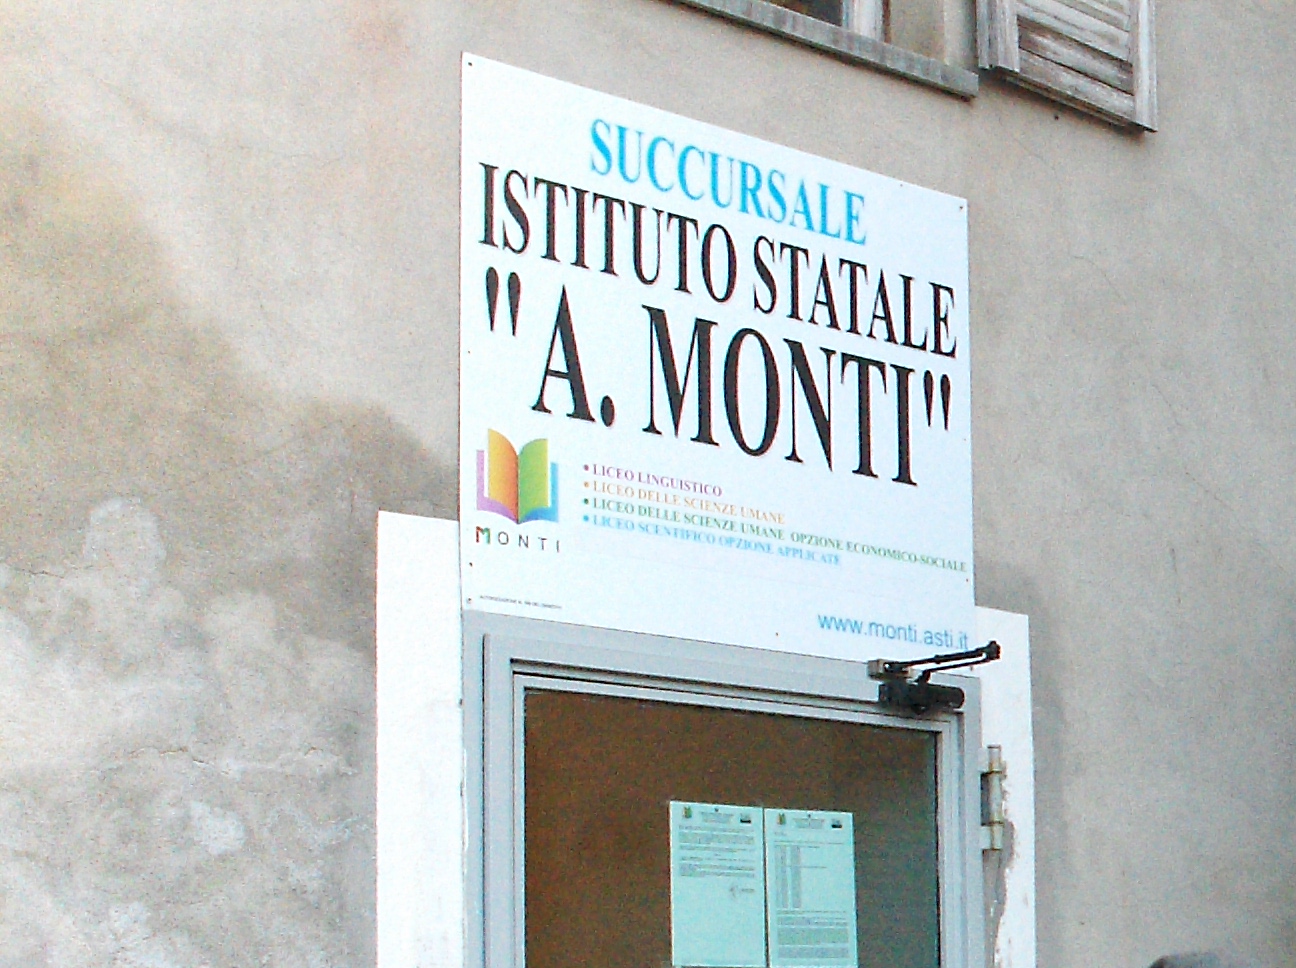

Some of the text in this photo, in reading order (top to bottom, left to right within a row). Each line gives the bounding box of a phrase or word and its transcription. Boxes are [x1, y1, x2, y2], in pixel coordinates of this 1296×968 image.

[591, 118, 867, 246] SUCCURSALE
[478, 162, 957, 358] ISTITUTO STATALE
[485, 266, 952, 486] "A. MONTI"
[593, 464, 722, 497] LICEO LINGUISTICO
[593, 481, 785, 525] LICEO DELLE SCIENZE UMANE
[476, 526, 560, 553] MONTI
[593, 498, 967, 572] LICEO DELLE SCIENZE UMANE OPZIONE ECONOMICO-SOCIALE
[593, 515, 634, 531] LICEO
[719, 535, 774, 554] OPZIONE
[777, 546, 840, 566] APPLICATE
[818, 614, 968, 650] www.monti.asti.it
